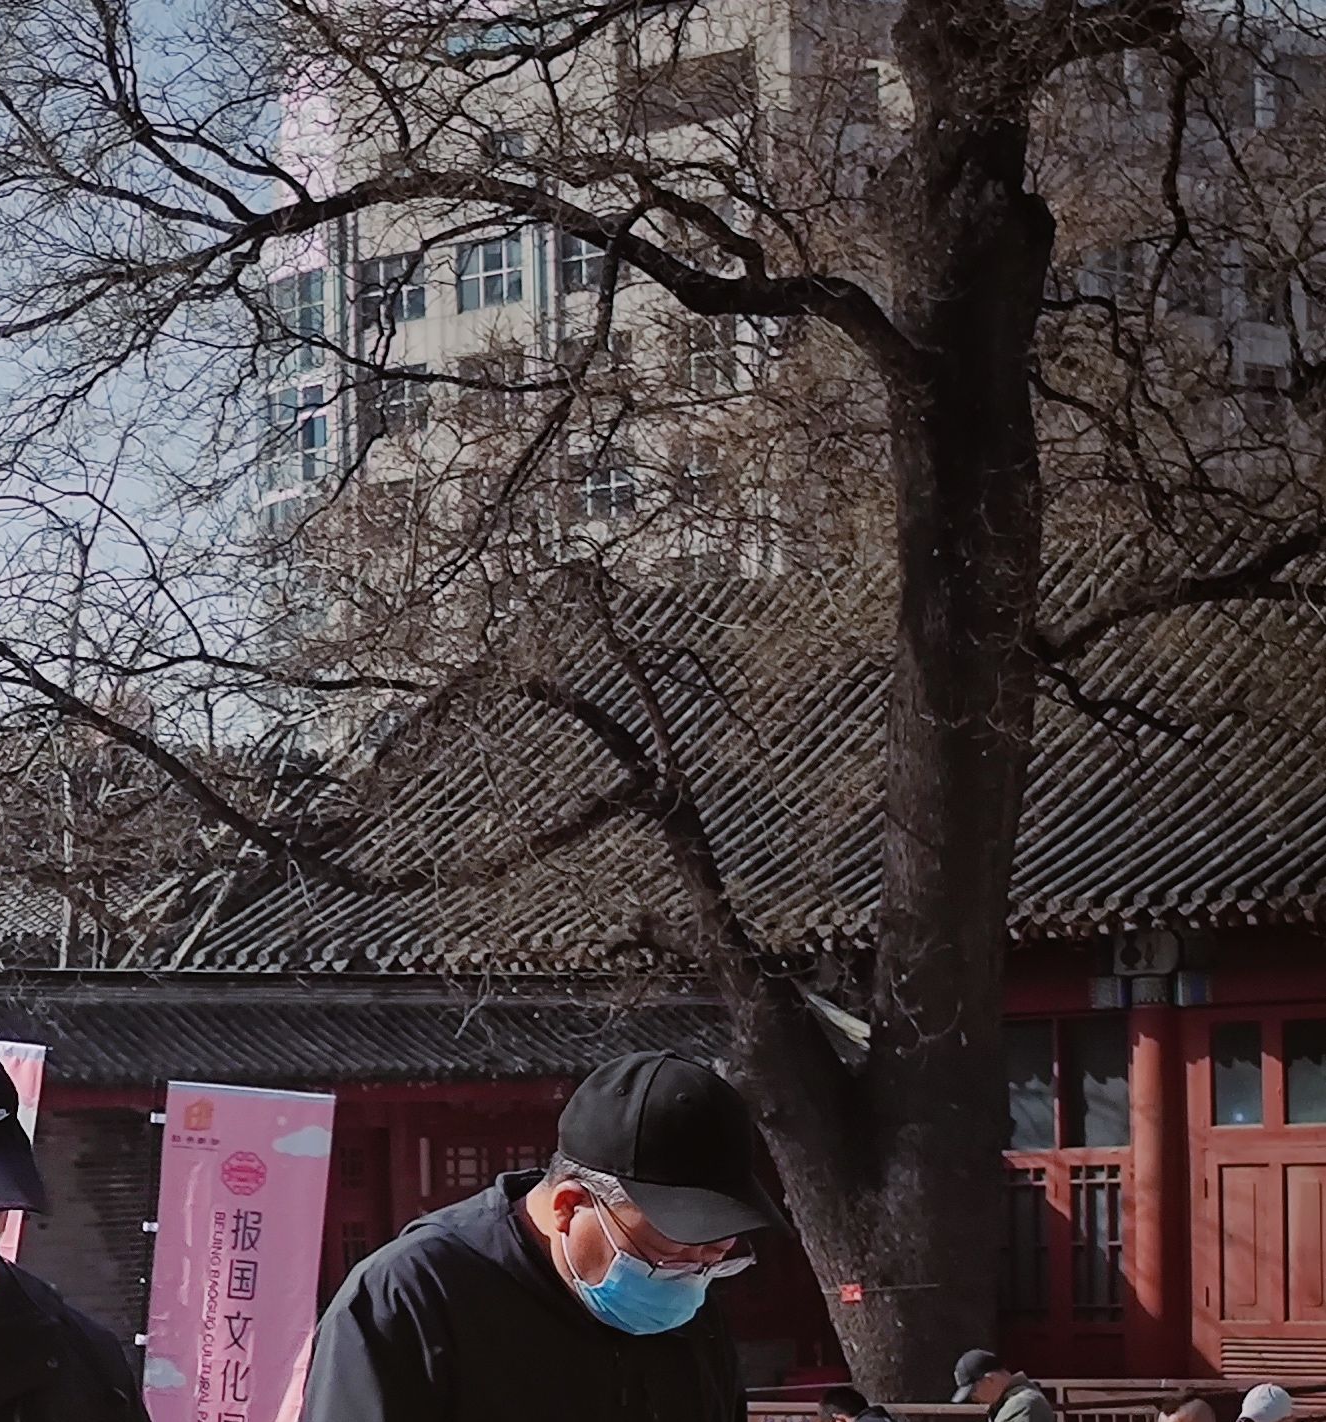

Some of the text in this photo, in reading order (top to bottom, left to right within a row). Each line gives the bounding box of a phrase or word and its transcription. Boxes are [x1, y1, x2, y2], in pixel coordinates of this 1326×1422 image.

[210, 1210, 226, 1266] BEIJING
[205, 1269, 220, 1330] BAOGUO
[198, 1333, 214, 1405] CULTURAL
